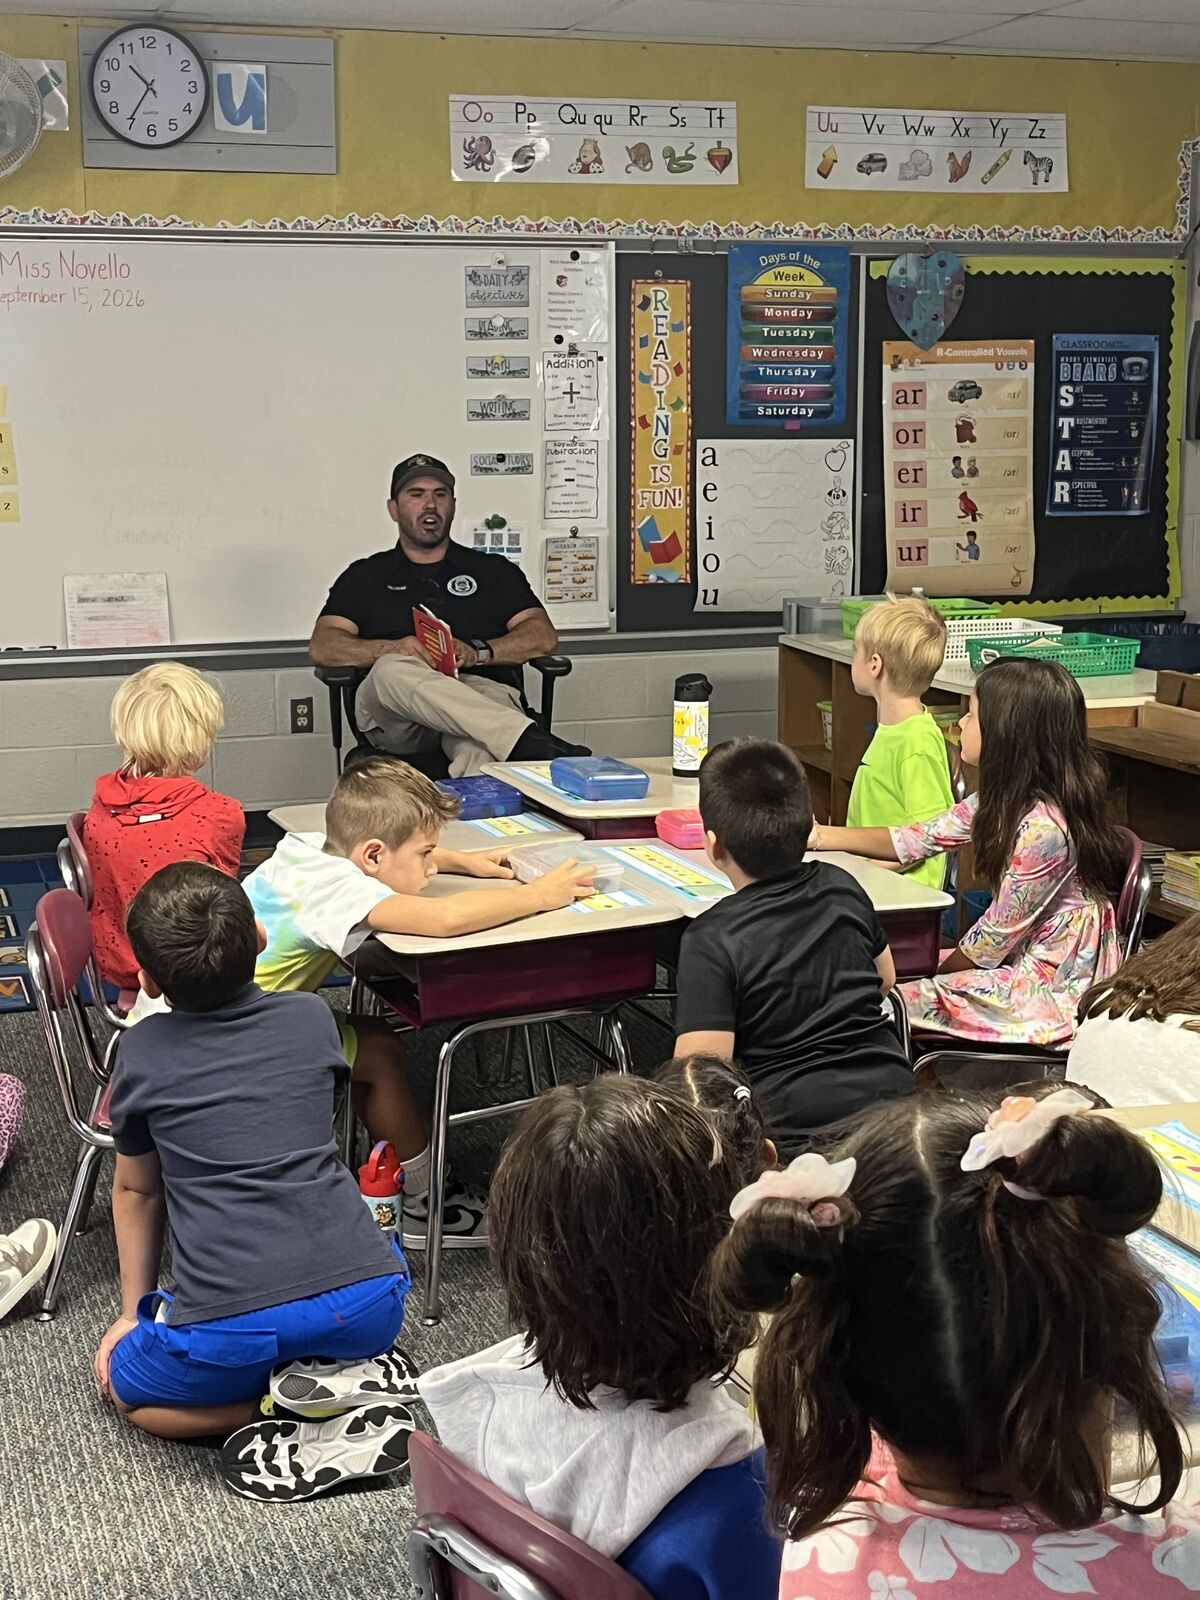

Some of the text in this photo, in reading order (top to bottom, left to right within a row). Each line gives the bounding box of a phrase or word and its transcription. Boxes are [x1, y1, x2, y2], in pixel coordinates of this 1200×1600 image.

[118, 42, 134, 55] 11
[138, 36, 156, 48] 12
[166, 43, 171, 55] 1
[105, 58, 120, 71] 10
[180, 60, 191, 72] 2
[100, 80, 110, 93] 9
[188, 81, 198, 94] 3
[109, 101, 119, 114] 8
[182, 102, 192, 114] 4
[126, 117, 135, 130] 7
[168, 118, 178, 131] 5
[463, 102, 725, 136] Oo Pp Qu qu Rr Ss Tt
[146, 124, 157, 137] 6
[817, 112, 1046, 148] Uu Vv Ww Xx Yy Zz
[0, 250, 131, 279] Miss Novello
[759, 251, 821, 269] Days of the
[773, 271, 805, 282] Week
[102, 289, 145, 307] 2026
[765, 288, 812, 300] Sunday
[764, 308, 813, 319] Monday
[762, 328, 815, 339] Tuesday
[1060, 340, 1115, 349] CLASSROOM
[752, 348, 824, 359] Wednesday
[996, 347, 1028, 356] Vowels
[546, 359, 595, 369] Addition
[652, 289, 670, 458] READING
[758, 367, 817, 378] Thursday
[1059, 362, 1117, 381] BEARS
[766, 386, 806, 398] Friday
[895, 387, 923, 405] ar
[757, 406, 814, 417] Saturday
[895, 428, 923, 445] or
[473, 456, 499, 466] SOCIA
[701, 446, 719, 467] a
[651, 465, 670, 484] IS
[897, 467, 924, 484] er
[639, 487, 682, 508] FUN!
[702, 482, 718, 502] e
[901, 503, 922, 523] ir
[705, 515, 715, 541] i
[897, 546, 927, 562] ur
[702, 553, 720, 573] o
[701, 588, 719, 606] u
